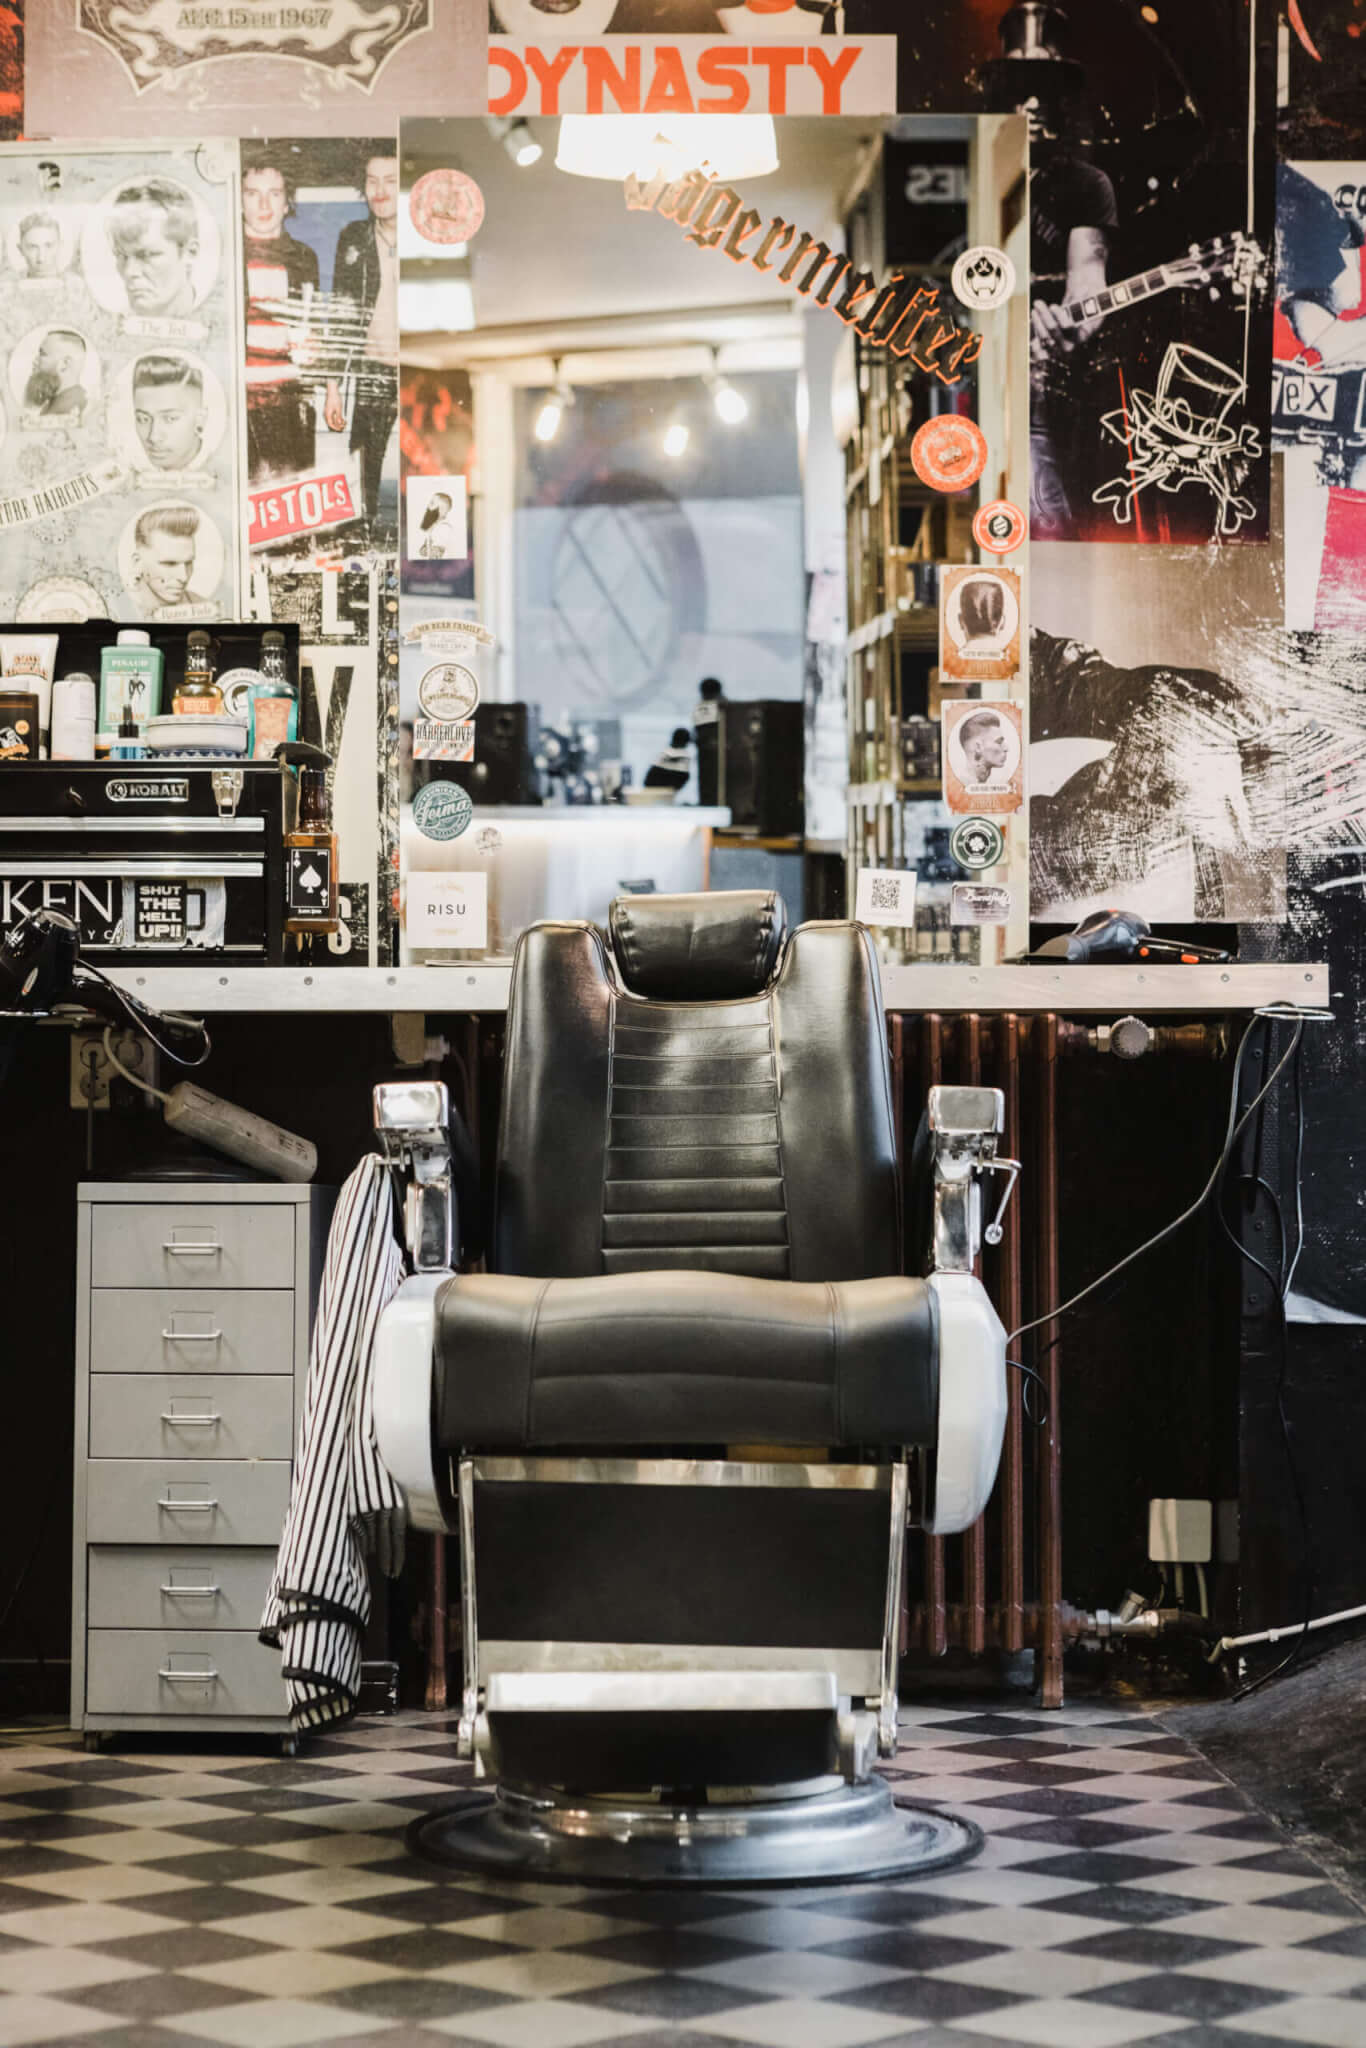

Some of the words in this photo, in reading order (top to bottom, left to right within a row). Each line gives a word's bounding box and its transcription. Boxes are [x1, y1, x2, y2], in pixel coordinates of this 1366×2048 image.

[279, 7, 333, 28] 1967
[32, 473, 100, 515] HAIRCUTS
[129, 783, 185, 797] KOBALT
[139, 885, 182, 896] SHUT
[139, 897, 182, 910] THE
[427, 903, 466, 916] RISU
[139, 911, 182, 923] HELL
[139, 924, 182, 938] UP!!
